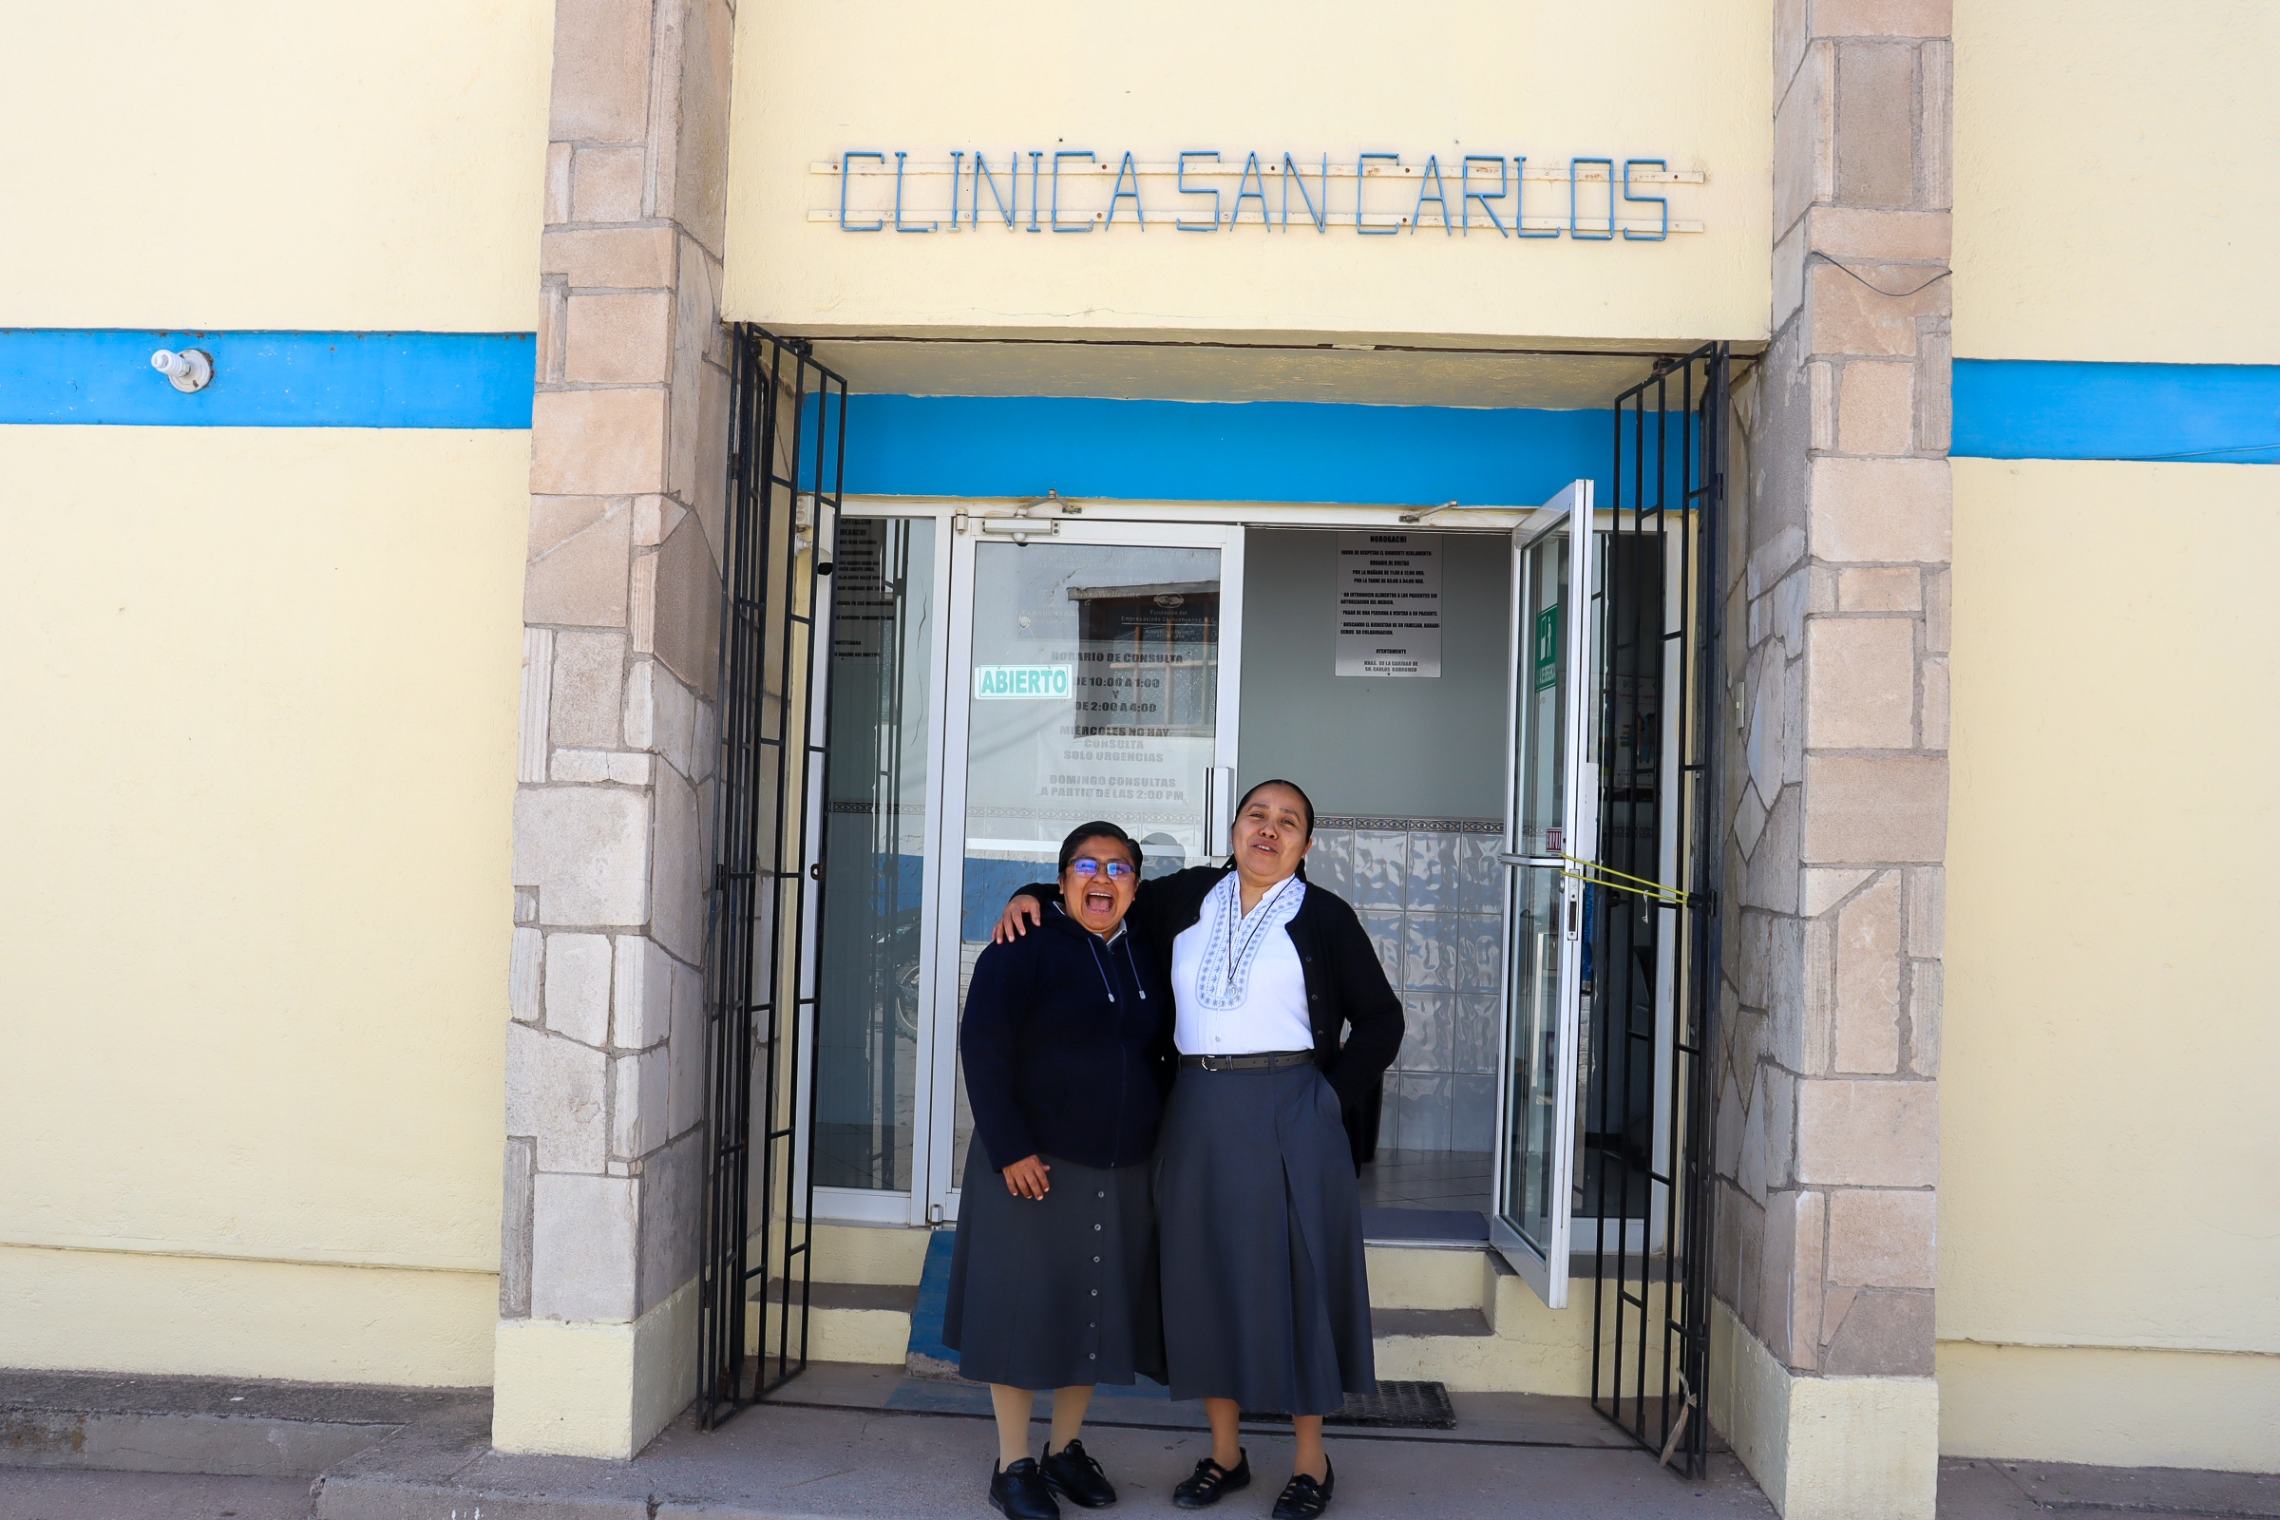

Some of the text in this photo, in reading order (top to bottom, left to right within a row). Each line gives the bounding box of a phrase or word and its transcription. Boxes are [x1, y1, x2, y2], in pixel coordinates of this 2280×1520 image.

[840, 151, 1667, 240] CLINICA SAN CARLOS
[1107, 653, 1120, 662] DE
[1124, 653, 1183, 663] CONSULTA
[981, 670, 1067, 693] ABIERTO
[1090, 677, 1122, 687] 10:00
[1125, 678, 1132, 687] A
[1136, 678, 1160, 688] 1:00
[1112, 690, 1119, 699] Y
[1075, 702, 1156, 712] DE 2:00 A 4:00
[1128, 728, 1144, 736] NO
[1147, 728, 1170, 737] HAY
[1084, 739, 1144, 750] CONSULTA
[1064, 750, 1164, 762] SOLO URGENCIAS
[1050, 774, 1176, 787] DOMINGO CONSULTAS
[1041, 787, 1049, 796] A
[1096, 788, 1111, 798] DE
[1113, 790, 1134, 798] LAS
[1136, 790, 1163, 800] 2:00
[1166, 791, 1184, 800] PM
